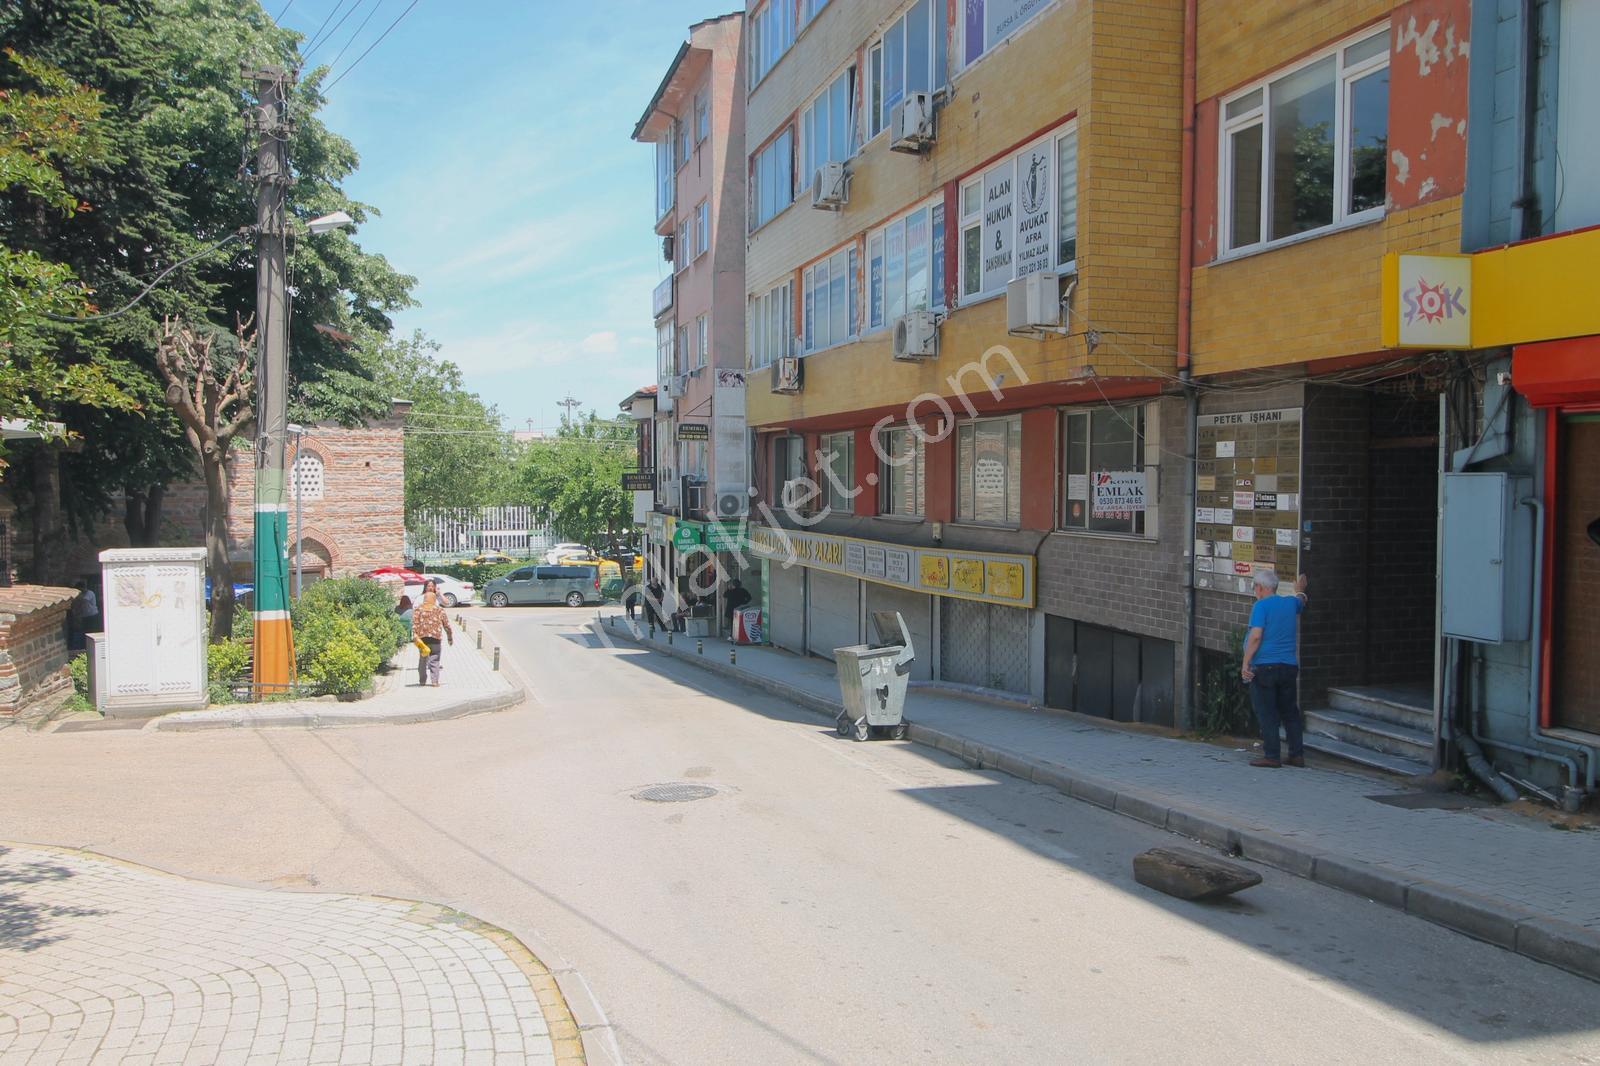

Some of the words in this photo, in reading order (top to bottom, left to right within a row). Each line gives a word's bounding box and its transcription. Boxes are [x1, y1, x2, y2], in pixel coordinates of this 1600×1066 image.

[988, 179, 1011, 202] ALAN
[986, 203, 1012, 227] HUKUK
[1020, 212, 1049, 233] AVUKAT
[995, 230, 1003, 251] &
[1025, 231, 1042, 250] AFRA
[1018, 248, 1036, 262] YILMAZ
[1036, 243, 1049, 256] ALAN
[1402, 286, 1467, 326] ŞOK
[1214, 414, 1243, 425] PETEK
[1250, 411, 1282, 423] İŞHANI
[1097, 486, 1144, 497] EMLAK
